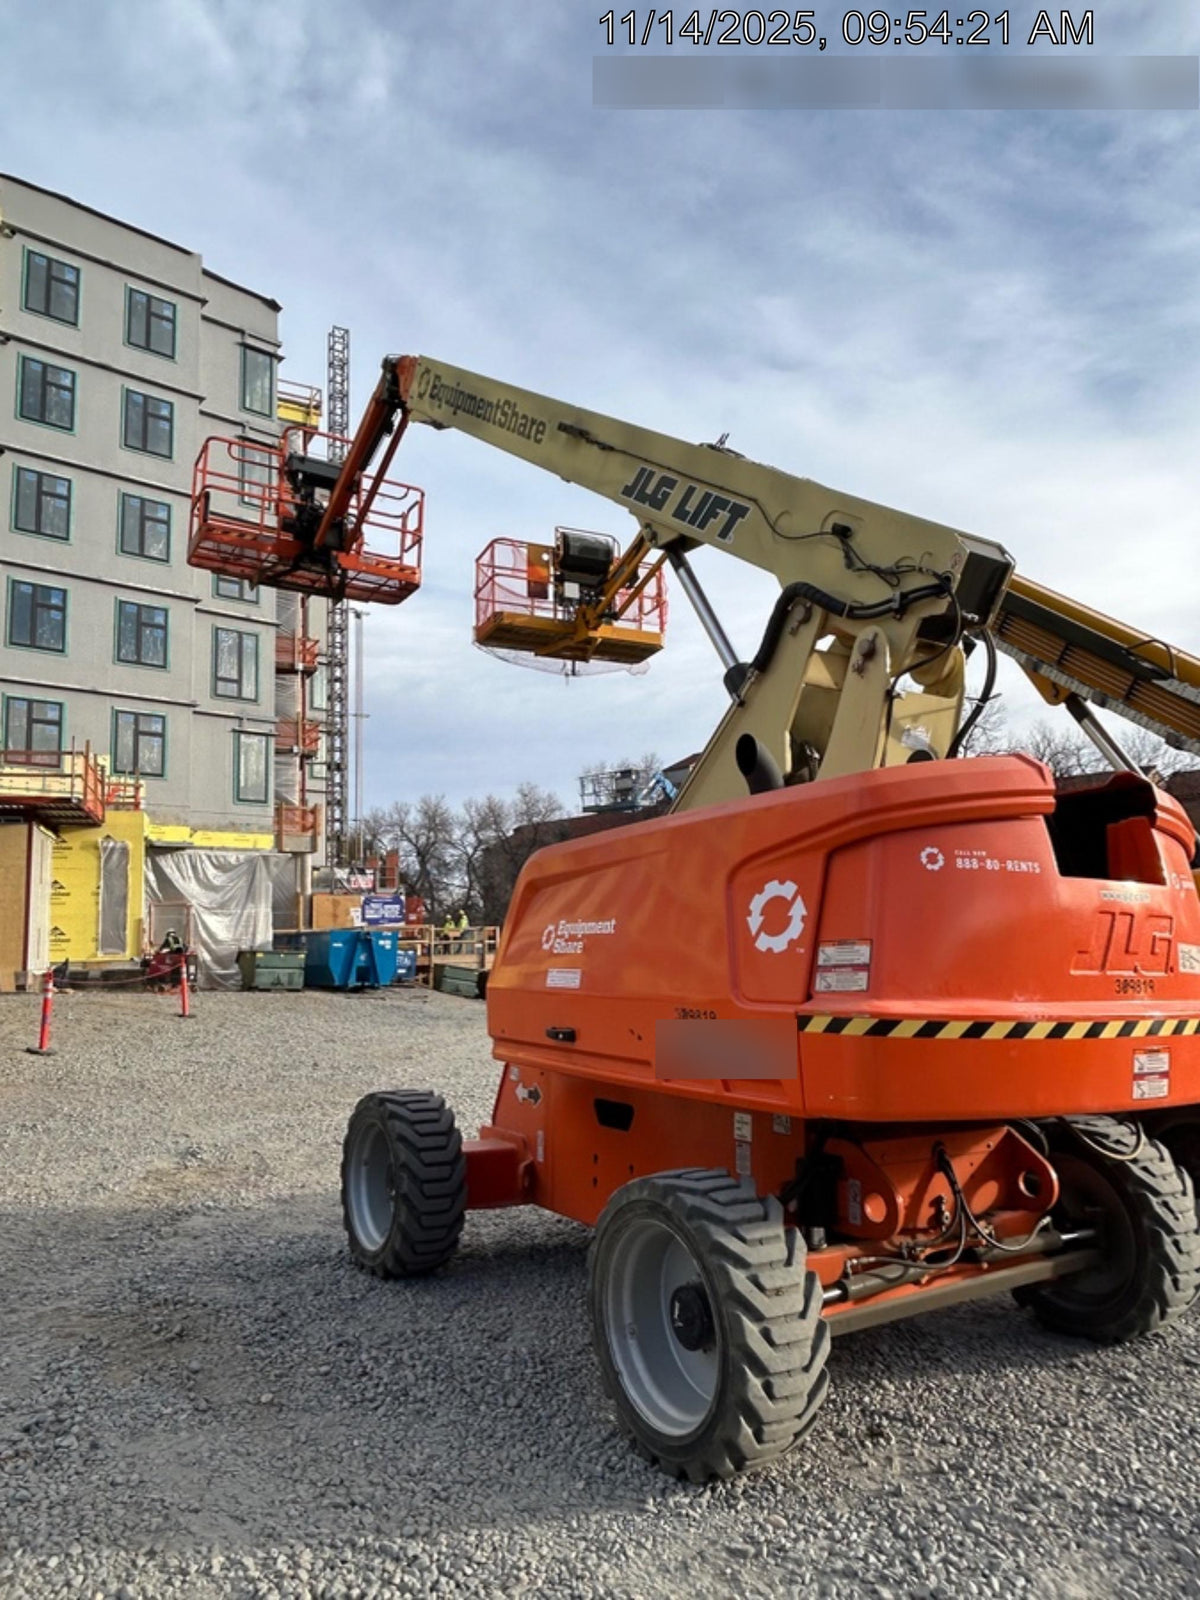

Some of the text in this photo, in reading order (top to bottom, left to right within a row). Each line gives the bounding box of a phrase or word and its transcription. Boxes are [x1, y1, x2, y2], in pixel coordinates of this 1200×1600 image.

[429, 374, 548, 445] EquipmentShare
[621, 465, 752, 541] JLG LIFT
[955, 857, 1041, 874] 888-80-RENTS
[557, 919, 616, 939] Equipment
